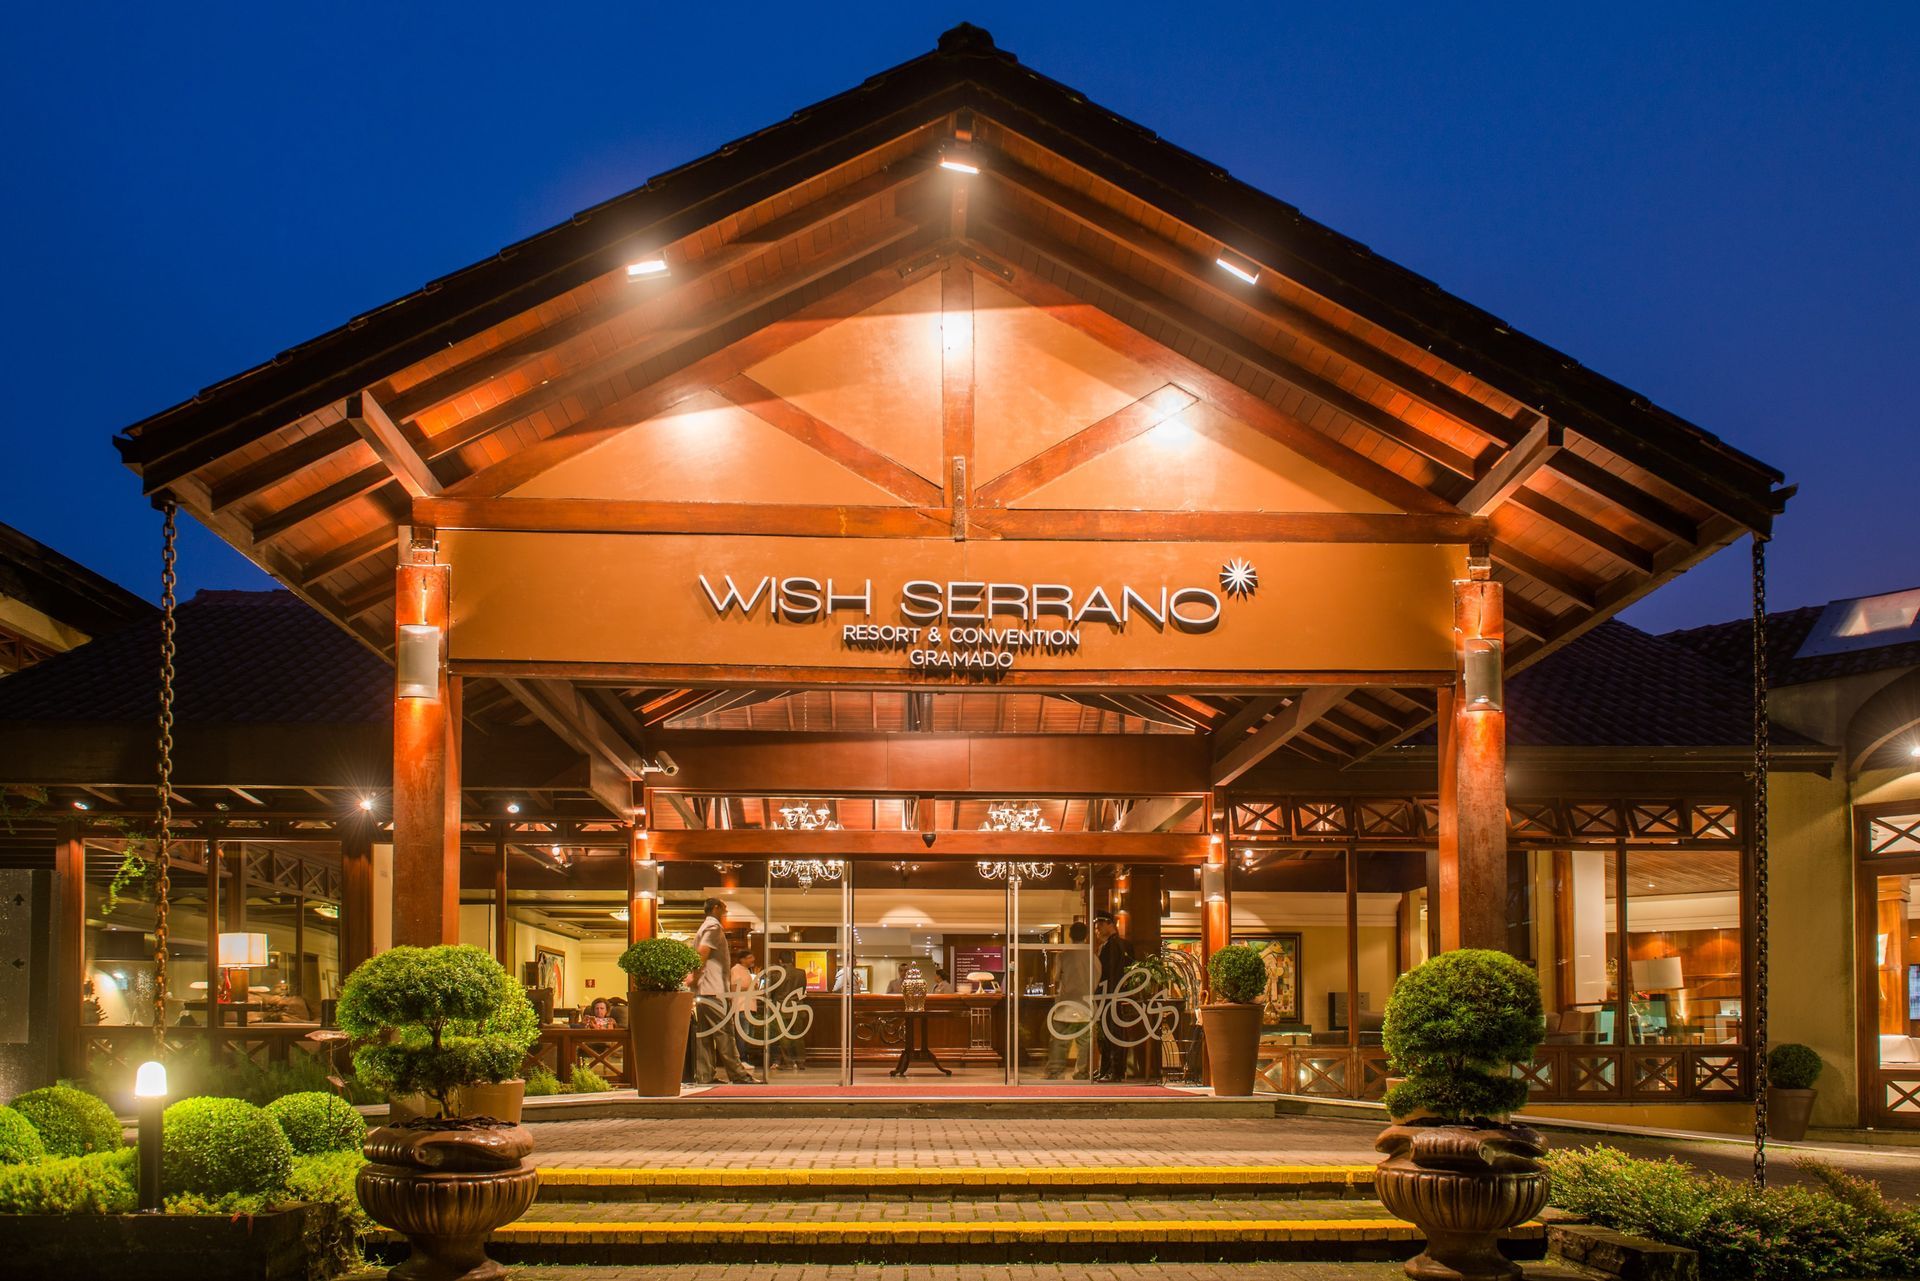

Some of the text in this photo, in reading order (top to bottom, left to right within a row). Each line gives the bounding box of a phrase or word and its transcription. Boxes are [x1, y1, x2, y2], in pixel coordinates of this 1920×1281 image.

[699, 575, 1221, 625] WISH SERRANO
[843, 624, 1080, 646] RESORT & CONVENTION
[910, 649, 1014, 668] GRAMADO
